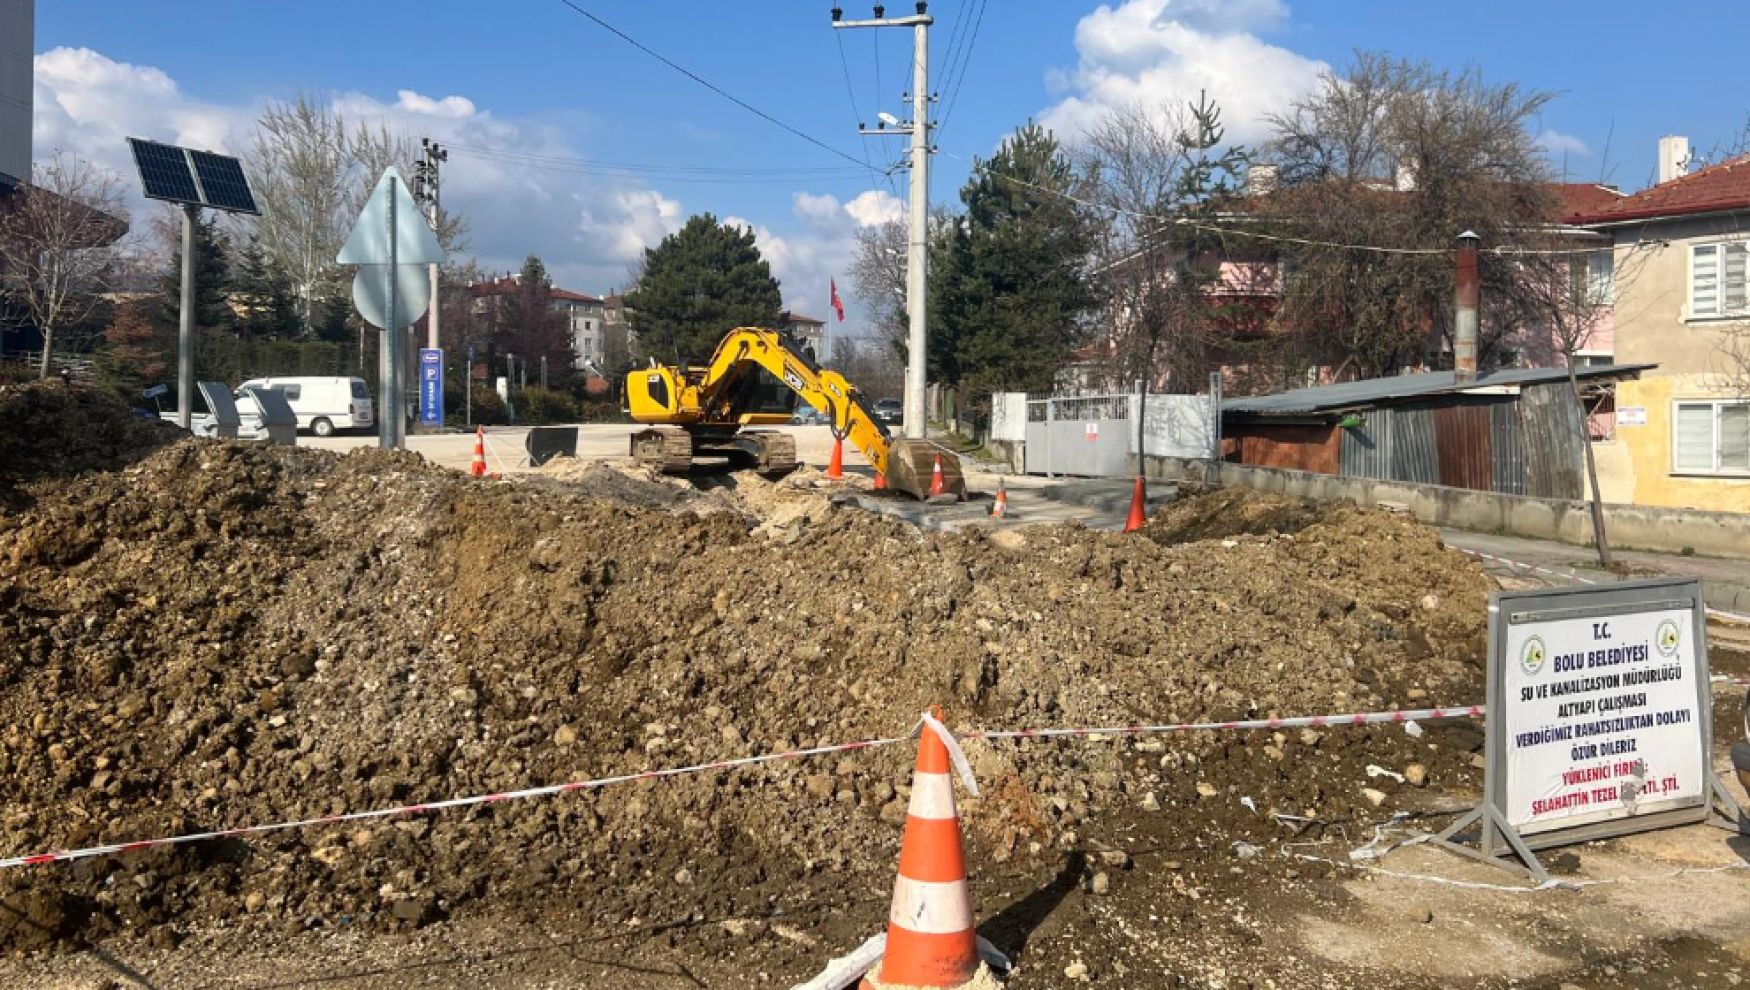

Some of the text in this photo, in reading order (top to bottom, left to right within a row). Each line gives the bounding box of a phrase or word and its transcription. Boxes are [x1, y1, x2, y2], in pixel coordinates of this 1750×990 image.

[1593, 622, 1611, 640] T.C.
[1554, 653, 1584, 672] BOLU
[1588, 639, 1649, 668] BELEDİYESİ
[1521, 663, 1681, 702] SU VE KANALİZASYON MÜDÜRLÜĞÜ
[1557, 693, 1646, 718] ALTYAPI ÇALIŞMASI
[1516, 709, 1690, 748] VERDİĞİMİZ RAHATSIZLIKTAN DOLAYI
[1571, 735, 1637, 760] ÖZÜR DİLERİZ
[1562, 760, 1611, 785] YÜKLENİCİ
[1532, 788, 1588, 815] SELAHATTİN
[1591, 786, 1617, 803] TEZEL
[1662, 773, 1680, 796] ŞTİ.
